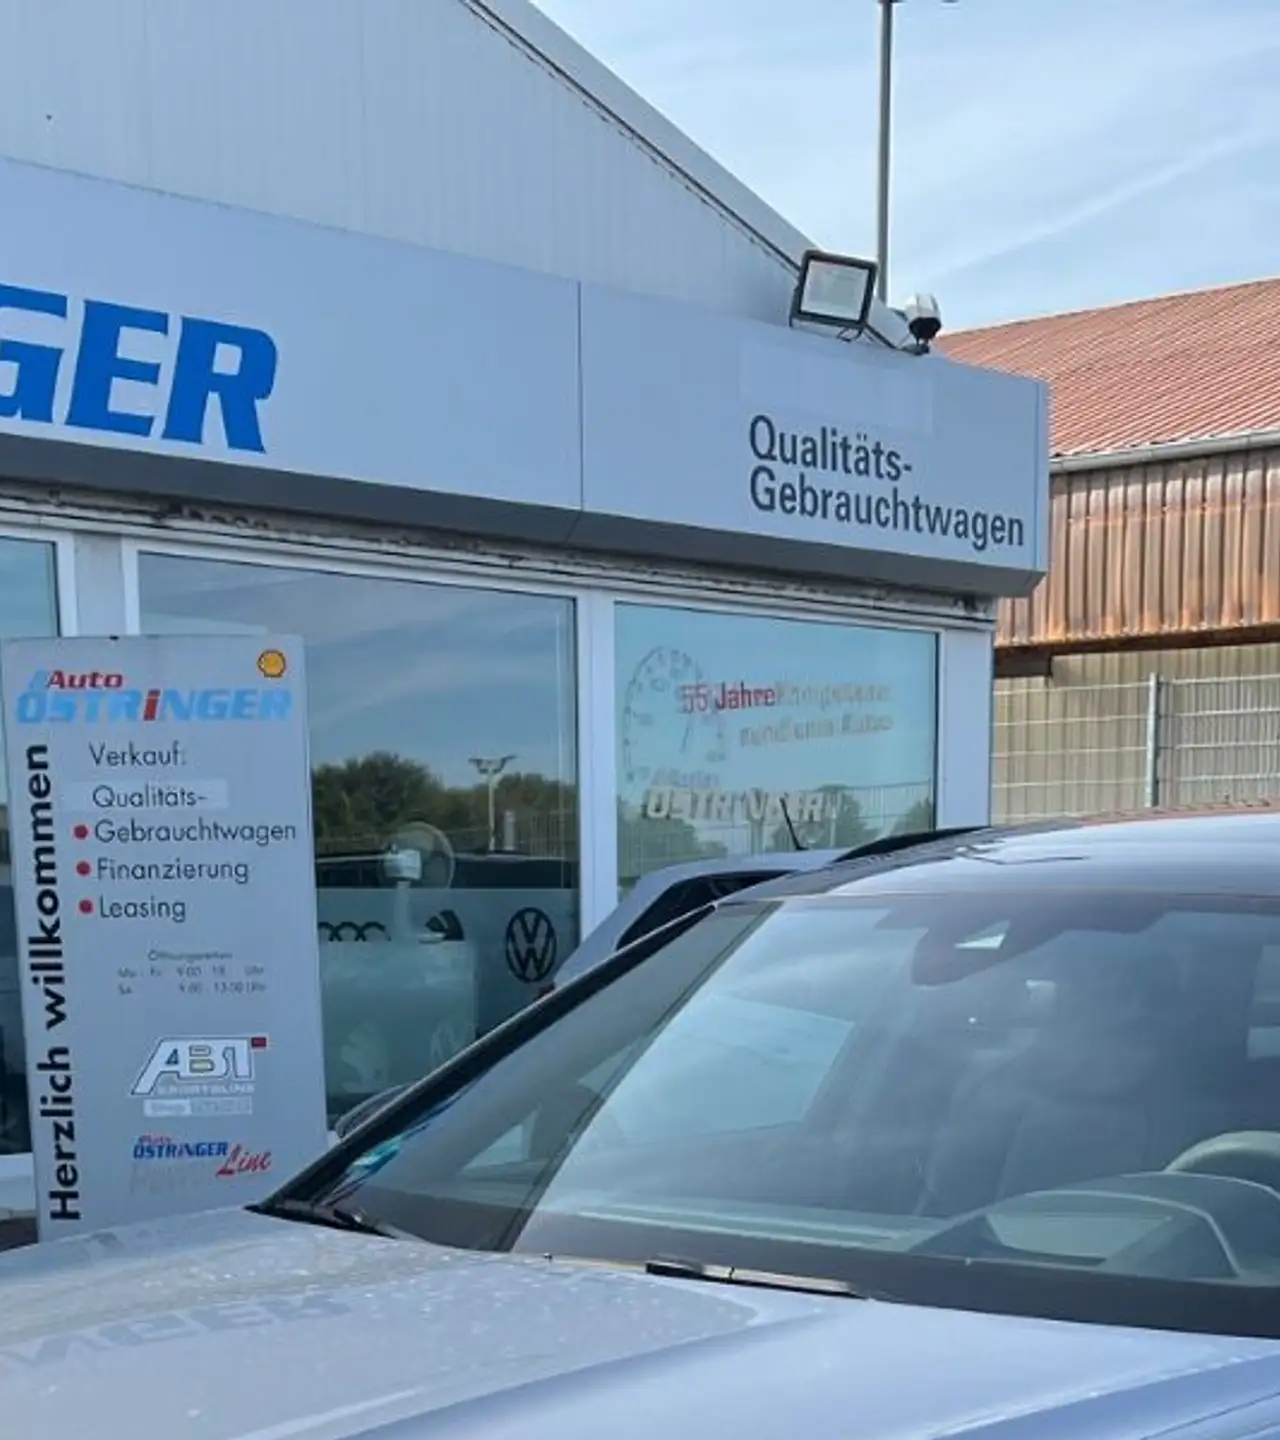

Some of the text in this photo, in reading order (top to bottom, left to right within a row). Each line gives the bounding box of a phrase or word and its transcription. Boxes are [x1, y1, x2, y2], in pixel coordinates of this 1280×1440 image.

[749, 414, 913, 482] Qualitäts-
[749, 465, 1025, 552] Gebrauchtwagen
[45, 669, 124, 690] Auto
[715, 681, 776, 710] Jahre
[92, 784, 208, 809] Qualitäts-
[94, 817, 297, 846] Gebrauchtwagen
[97, 857, 249, 884] Finanzierung
[99, 895, 187, 923] Leasing
[26, 744, 82, 1221] Herzlich willkommen
